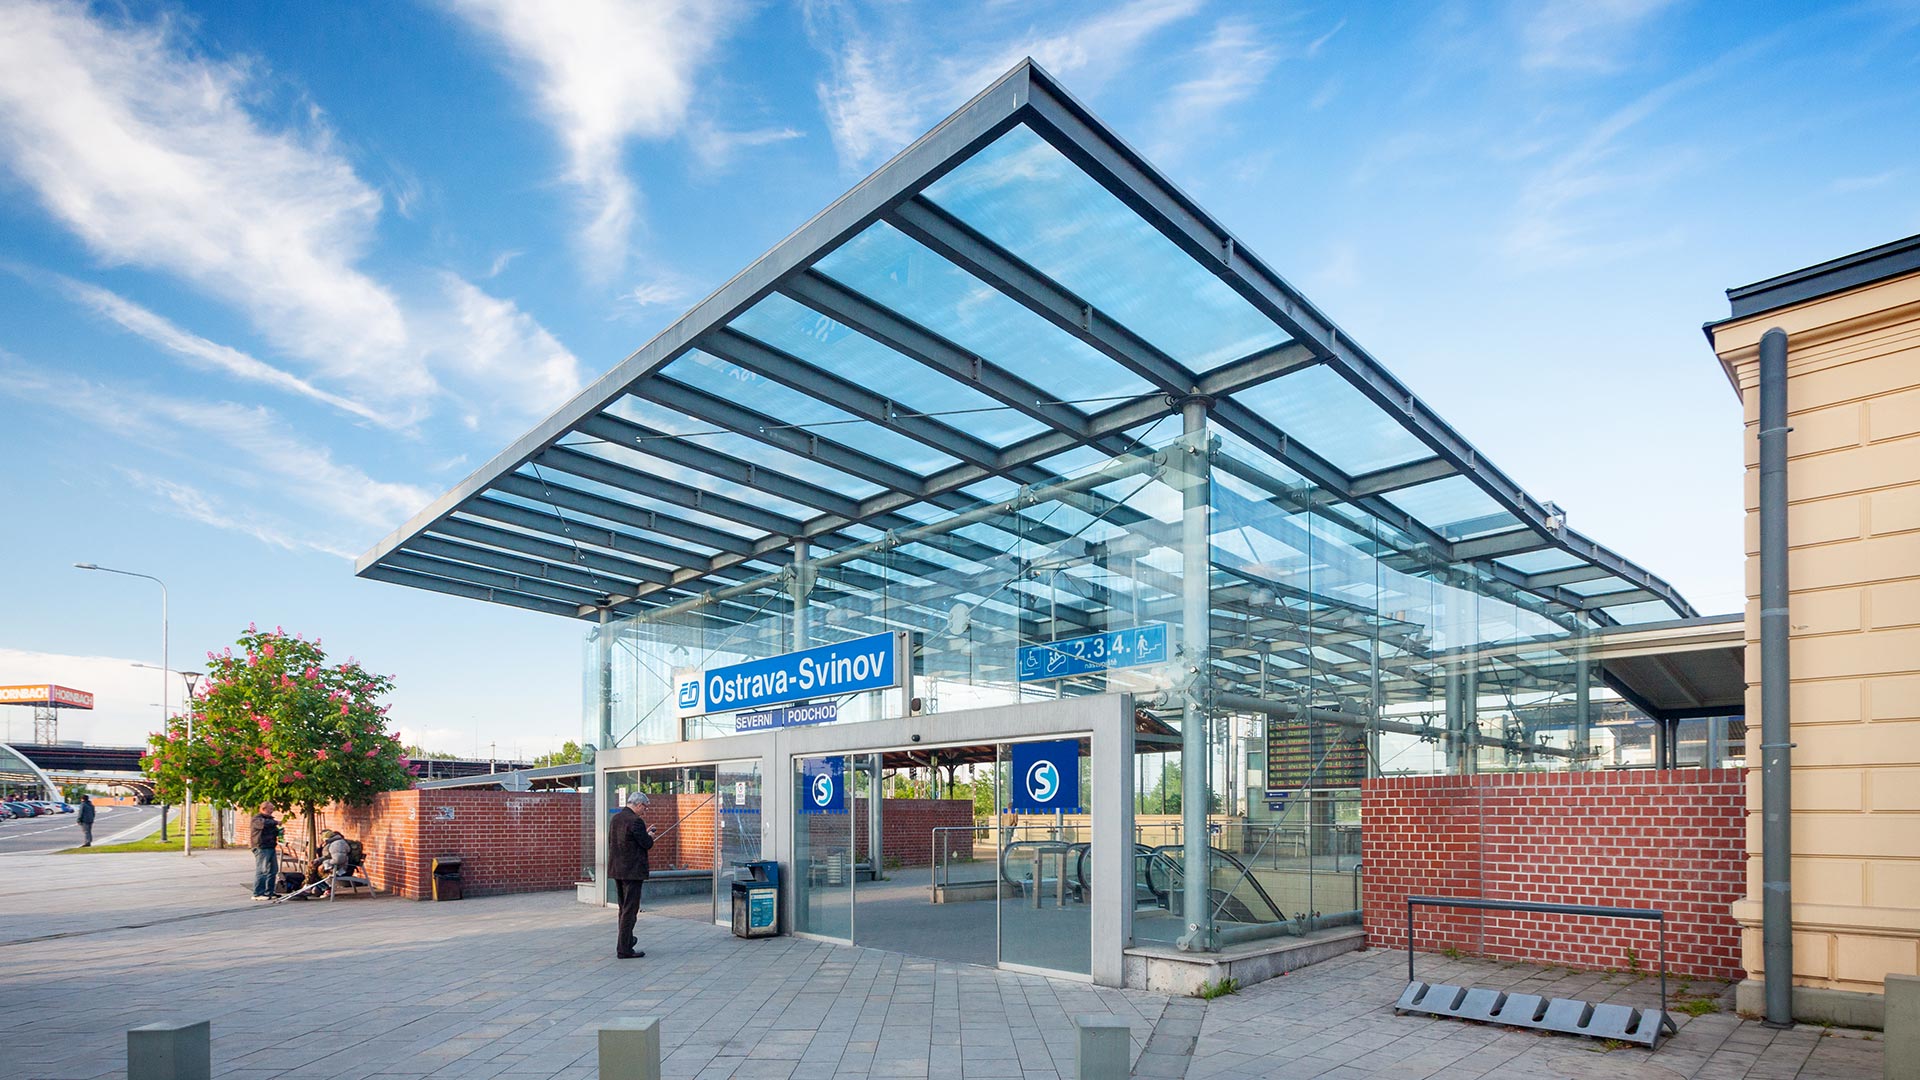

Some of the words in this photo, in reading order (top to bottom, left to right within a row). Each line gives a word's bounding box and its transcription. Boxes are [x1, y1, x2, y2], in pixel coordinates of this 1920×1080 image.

[709, 651, 885, 705] Ostrava-Svinov
[55, 687, 94, 705] HORNBACH
[736, 710, 773, 730] SEVERNÍ
[788, 705, 837, 724] PODCHOD
